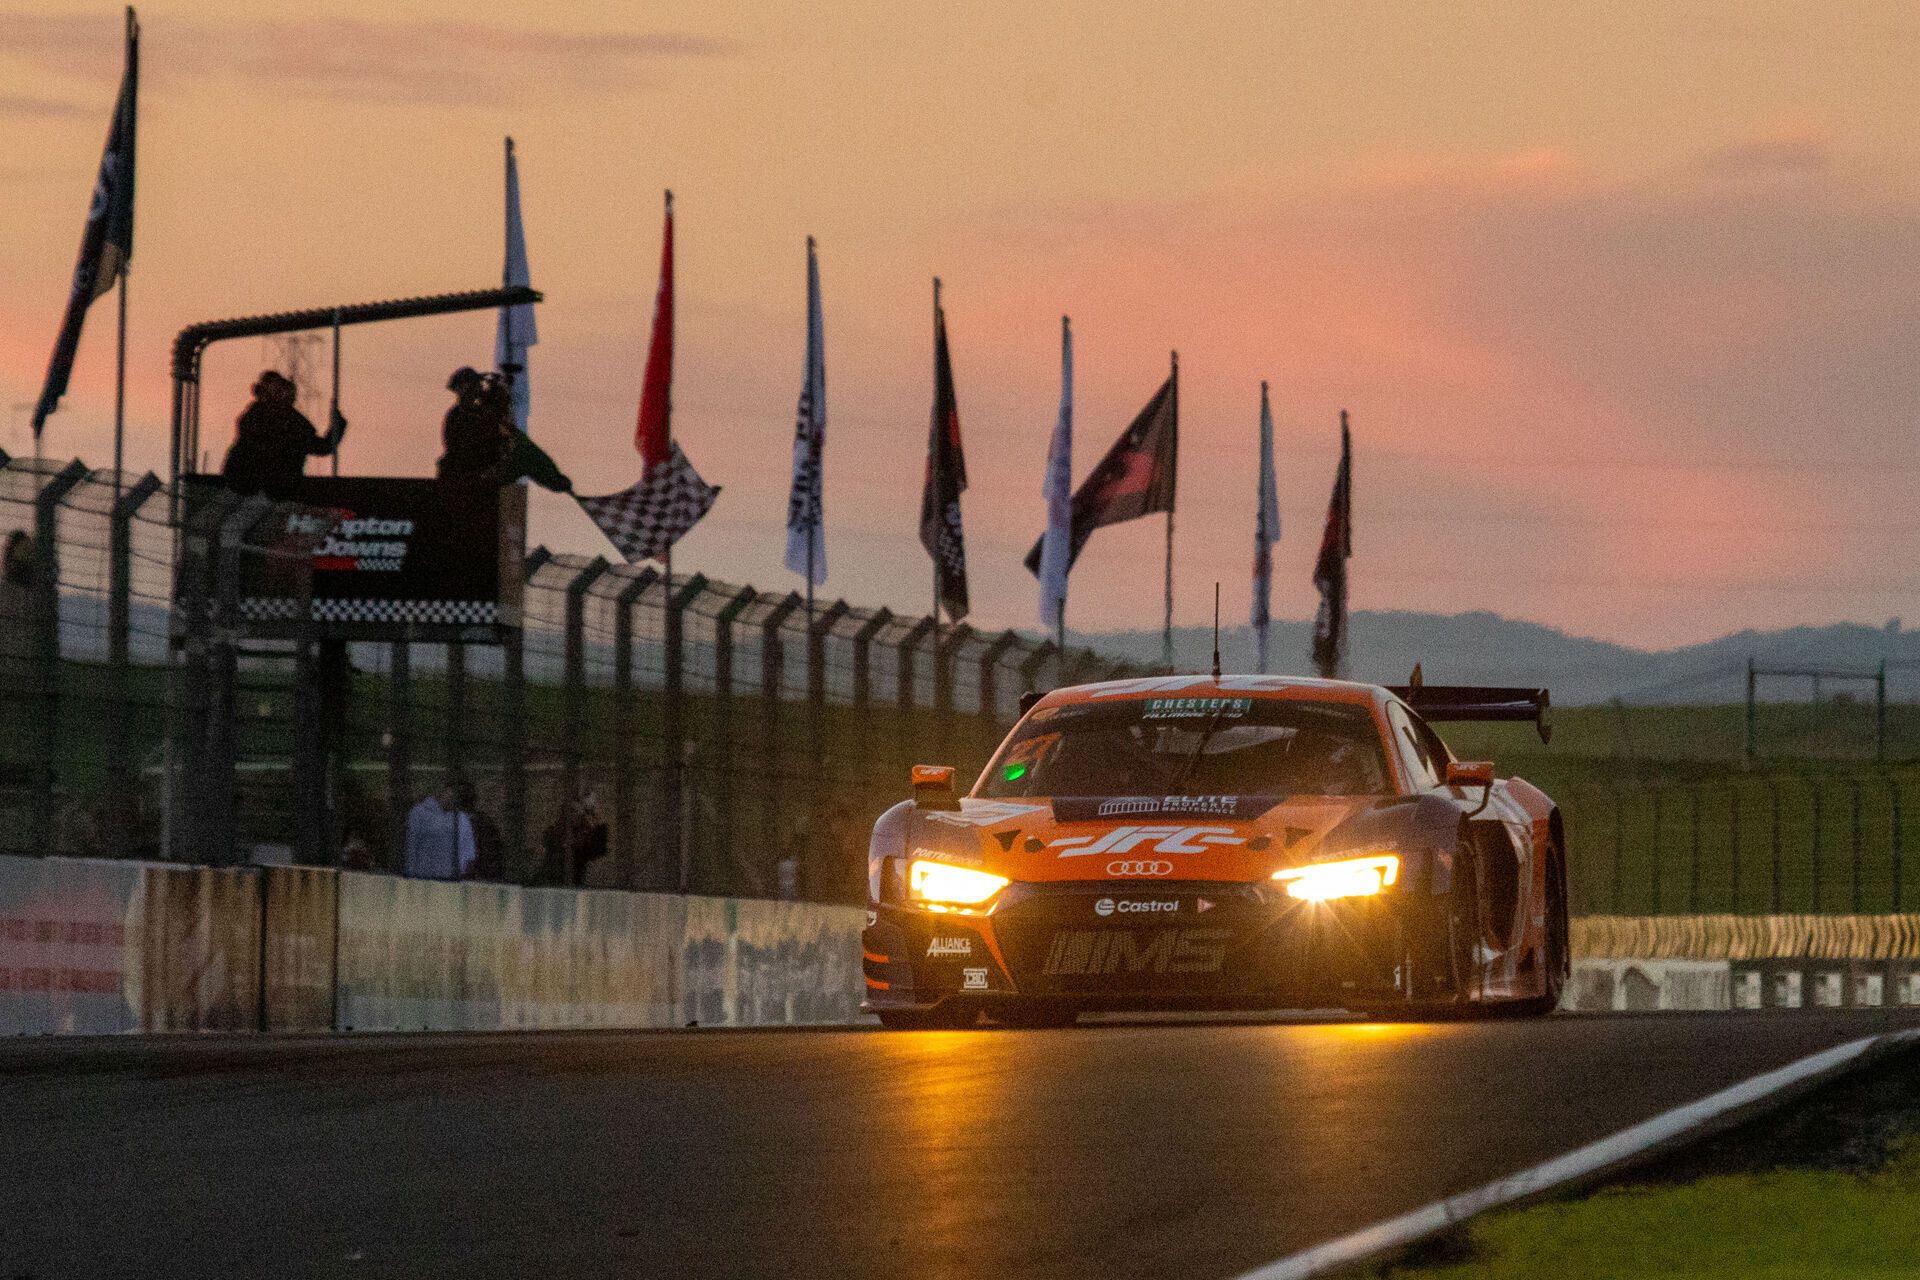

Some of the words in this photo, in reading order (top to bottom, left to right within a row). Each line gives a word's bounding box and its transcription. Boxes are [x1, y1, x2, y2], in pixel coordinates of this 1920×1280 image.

[1163, 802, 1237, 810] PROPERTY
[1117, 899, 1180, 913] Castrol
[927, 937, 971, 957] ALLIANCE
